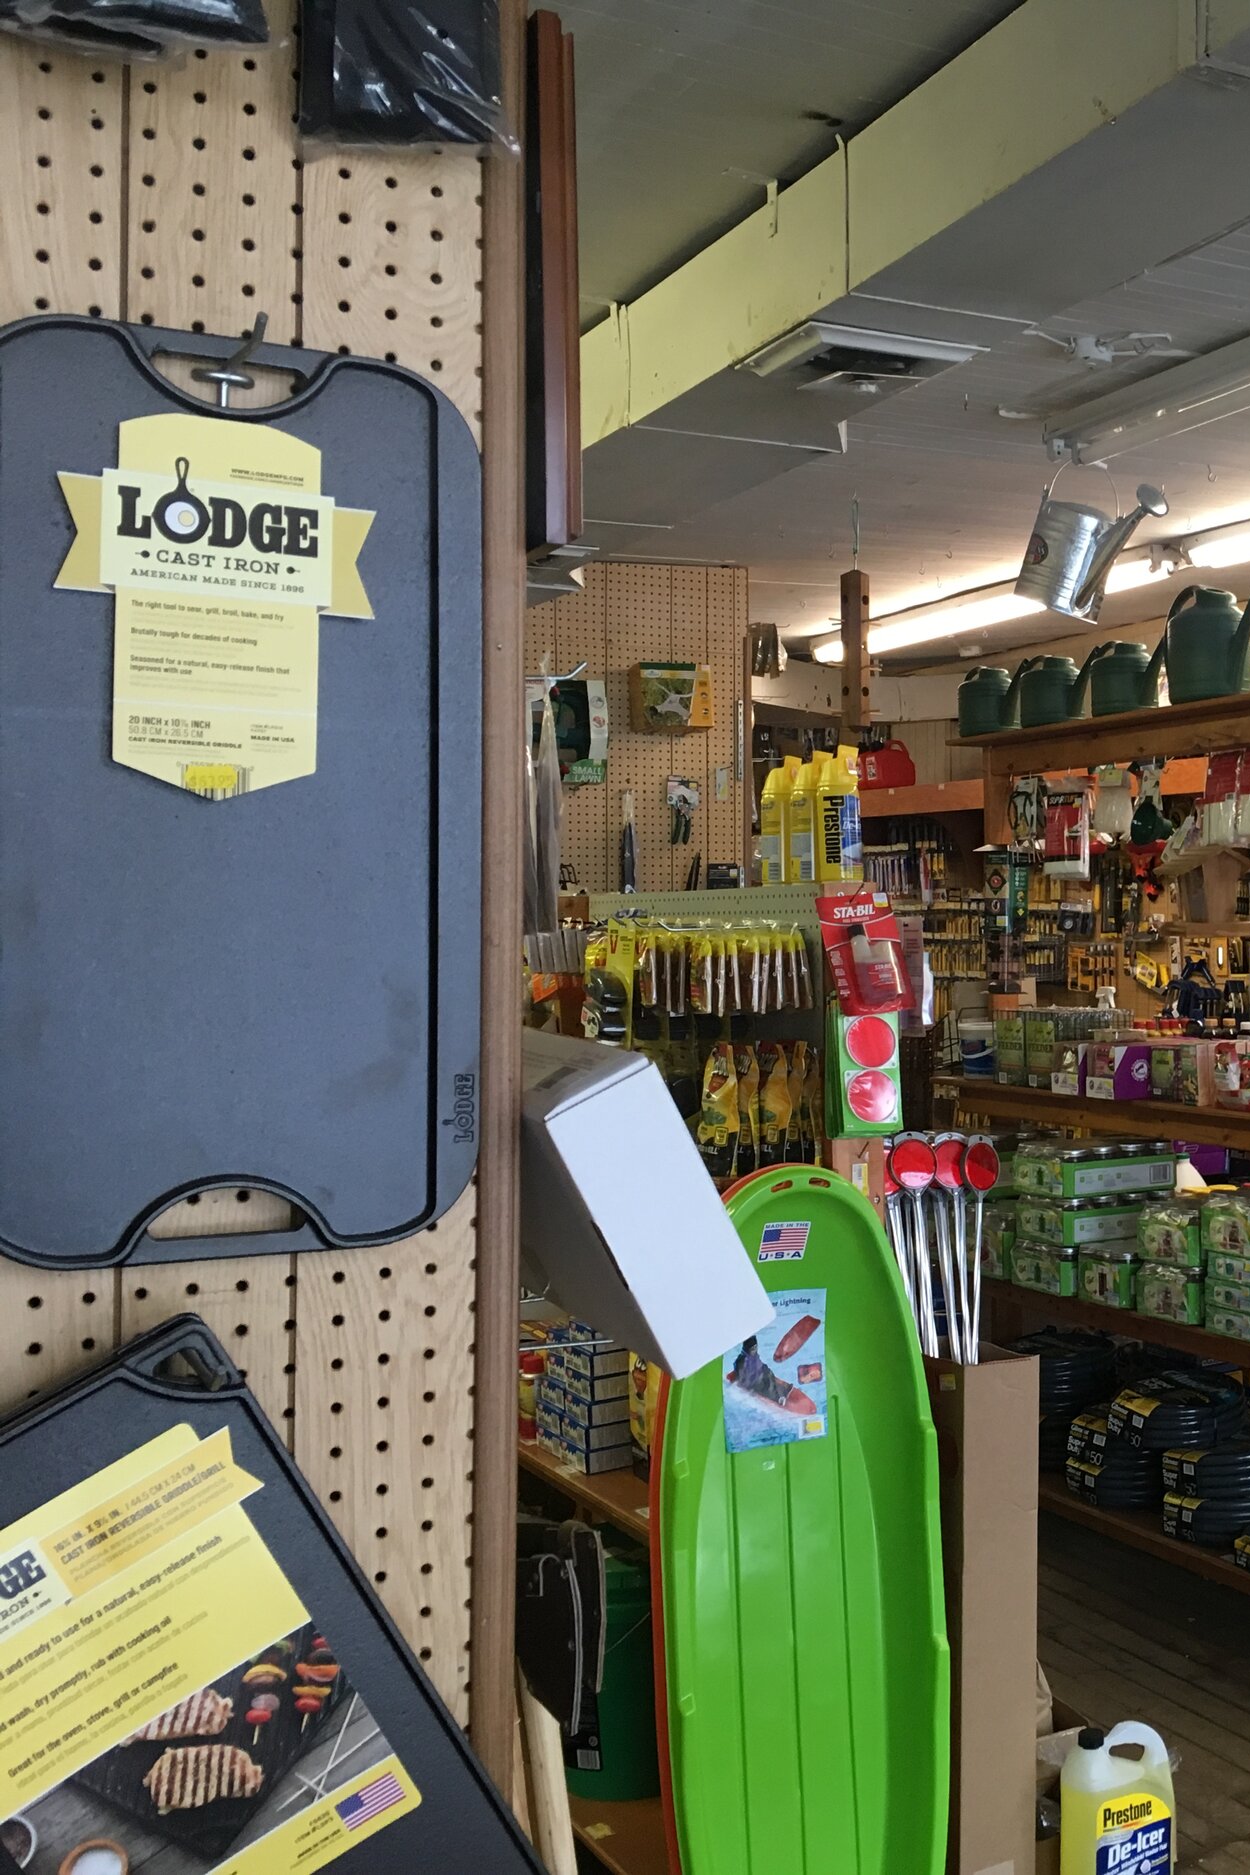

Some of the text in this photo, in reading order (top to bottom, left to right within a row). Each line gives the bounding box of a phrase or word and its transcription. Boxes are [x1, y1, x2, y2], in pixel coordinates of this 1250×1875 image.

[117, 475, 318, 558] LODGE
[156, 549, 280, 575] CAST IRON
[130, 568, 197, 582] AMERICAN
[203, 575, 236, 586] MADE
[241, 580, 277, 591] SINCE
[131, 600, 143, 608] The
[145, 600, 162, 611] right
[164, 602, 176, 610] tool
[222, 608, 239, 617] broil,
[261, 611, 273, 620] and
[275, 614, 284, 622] fry
[131, 627, 158, 638] Brutally
[160, 629, 180, 639] tough
[181, 632, 190, 640] for
[192, 632, 220, 642] decades
[231, 636, 258, 647] cooking
[130, 654, 164, 664] Seasoned
[166, 657, 175, 665] for
[183, 658, 210, 669] natural,
[210, 662, 254, 672] easy-release
[256, 664, 274, 674] finish
[276, 666, 290, 675] that
[130, 664, 192, 676] improves with use
[128, 716, 210, 730] 20 INCH x INCH
[149, 726, 162, 736] CM
[191, 730, 204, 738] CM
[168, 739, 210, 748] REVERSIBLE
[282, 736, 295, 744] USA
[572, 766, 603, 774] SMALL
[574, 775, 601, 783] LAWN
[823, 796, 845, 865] Prestone
[834, 904, 875, 918] STA-BIL
[449, 1073, 475, 1143] LODGE
[780, 1296, 811, 1308] Lightning
[59, 1460, 226, 1565] CAST IRON REVERSIBLE GRIDDLE/GRILL
[3, 1658, 24, 1676] and
[22, 1641, 51, 1664] ready
[50, 1633, 62, 1645] to
[61, 1622, 81, 1638] use
[79, 1613, 95, 1627] for
[101, 1586, 140, 1613] natural,
[138, 1550, 199, 1591] easy-release
[195, 1533, 223, 1555] finish
[6, 1615, 172, 1726] wash, dry promptly, rub with cooking oil
[7, 1661, 180, 1778] Great for the oven, stove, grill or campfire
[1103, 1801, 1152, 1828] Prestone
[1108, 1828, 1165, 1869] De-Icer
